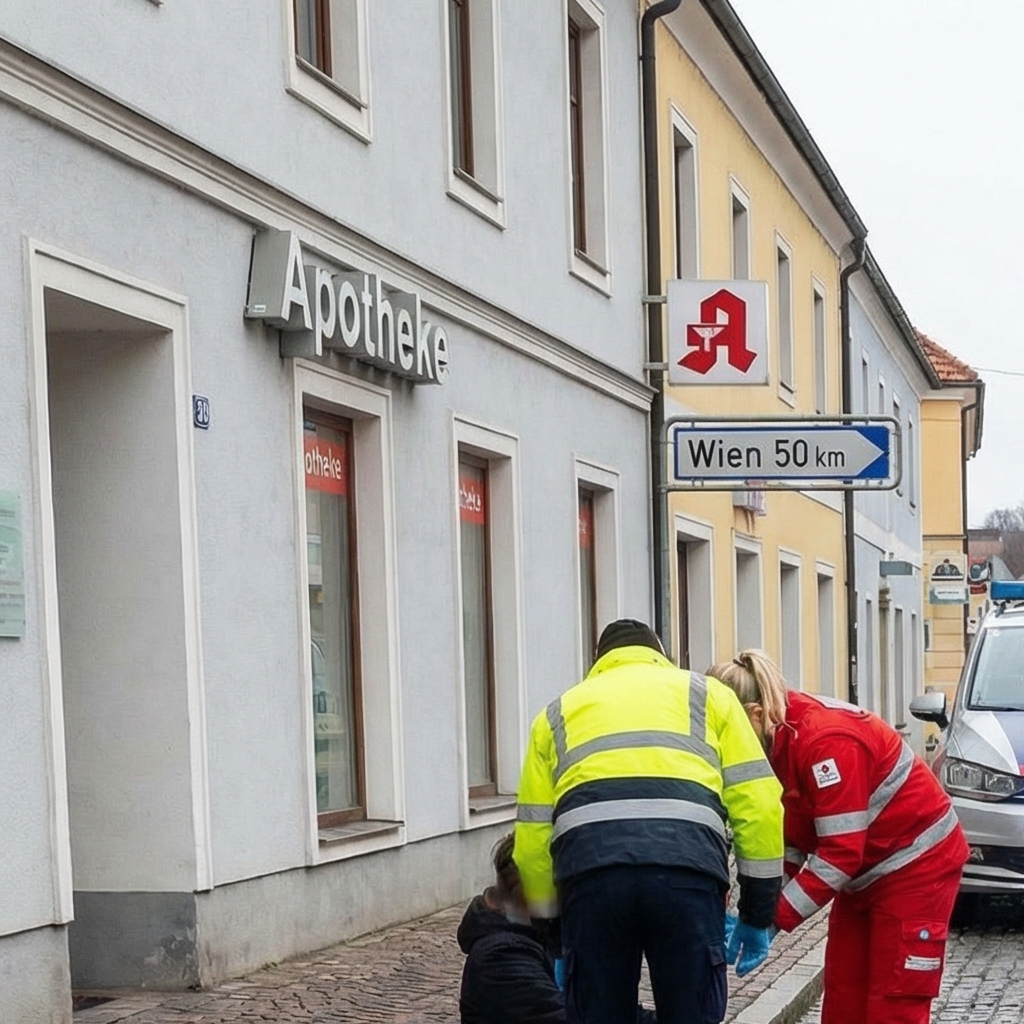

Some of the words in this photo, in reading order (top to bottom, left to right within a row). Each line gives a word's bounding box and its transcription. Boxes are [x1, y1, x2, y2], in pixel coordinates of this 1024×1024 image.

[281, 230, 449, 385] Apotheke
[688, 439, 761, 468] Wien
[775, 438, 808, 468] 50
[816, 445, 845, 467] km
